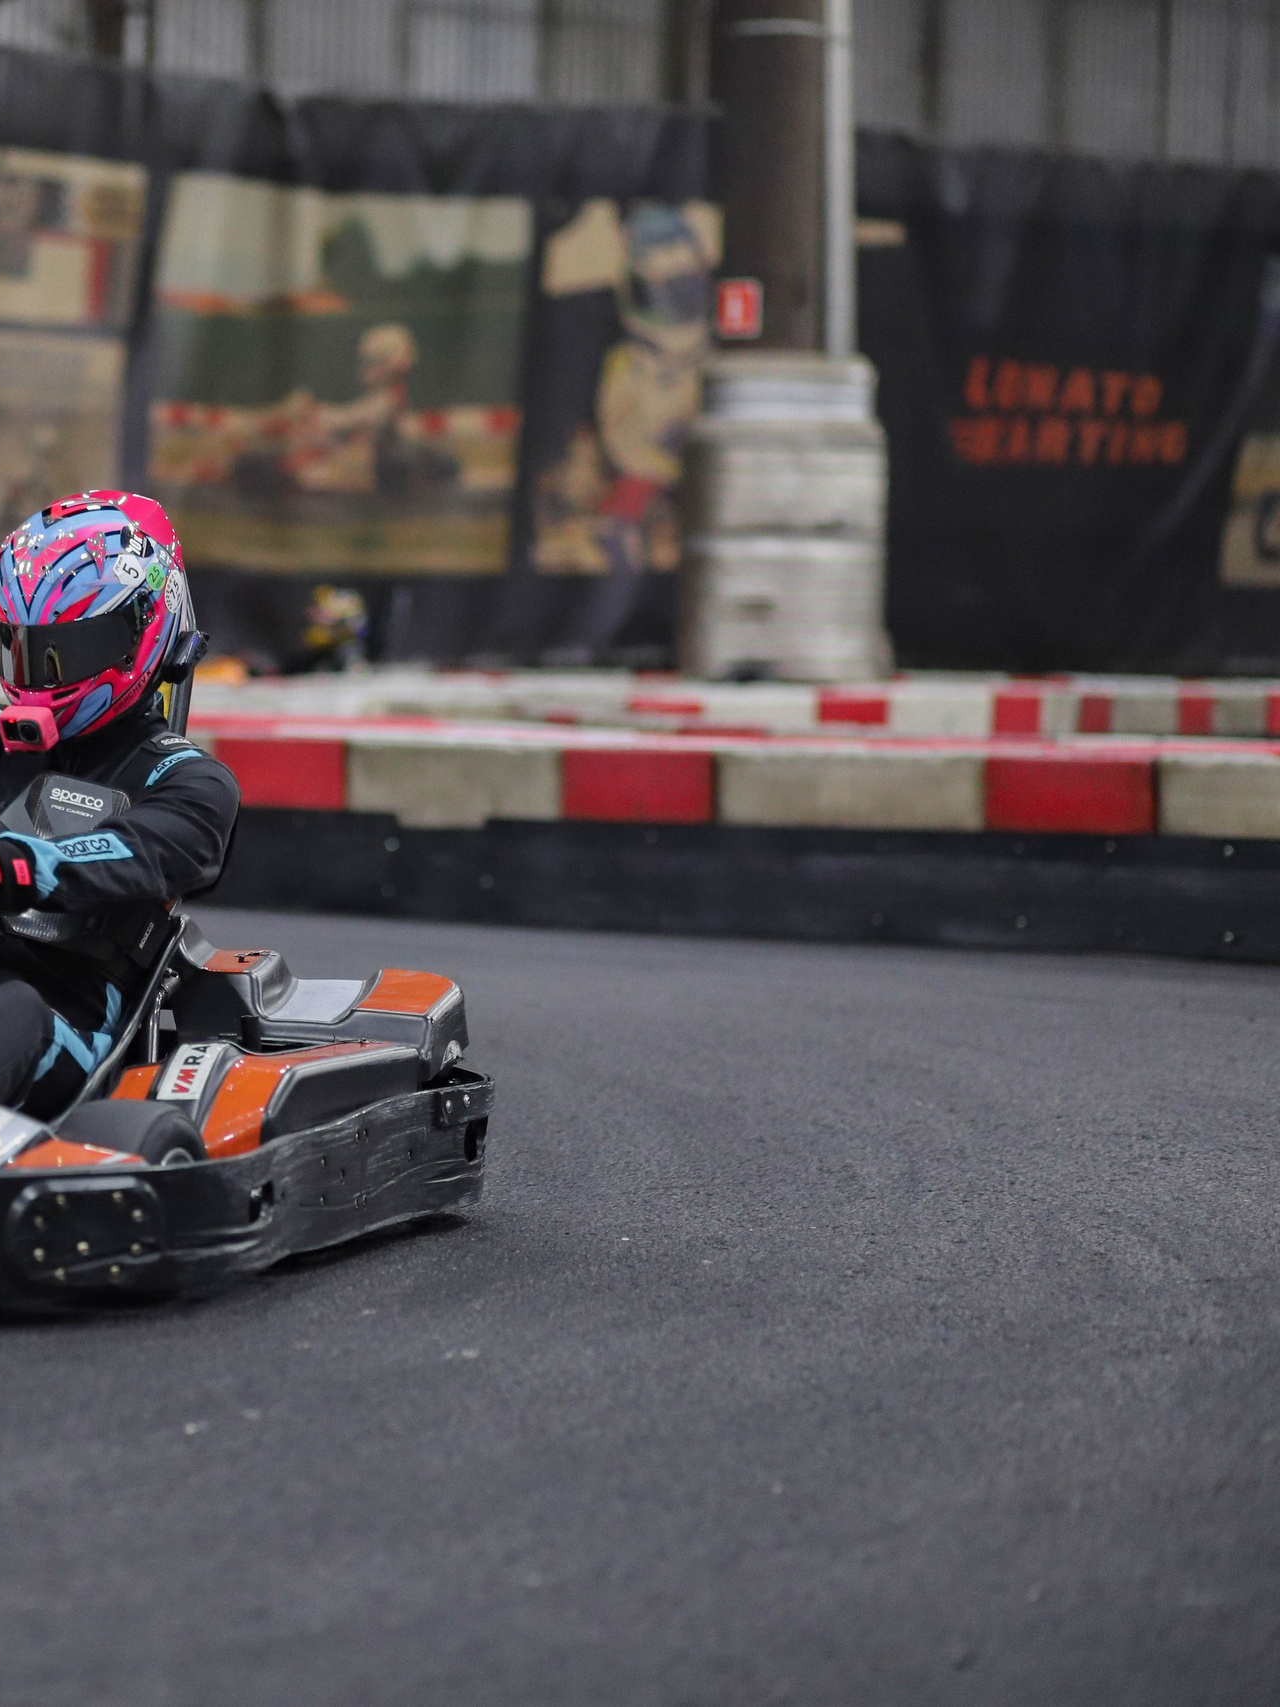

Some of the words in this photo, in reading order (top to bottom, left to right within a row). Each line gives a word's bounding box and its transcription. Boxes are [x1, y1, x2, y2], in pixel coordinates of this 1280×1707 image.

[122, 562, 140, 580] 5
[51, 787, 104, 809] sparco
[50, 803, 65, 812] PRO
[65, 807, 94, 819] CARBON
